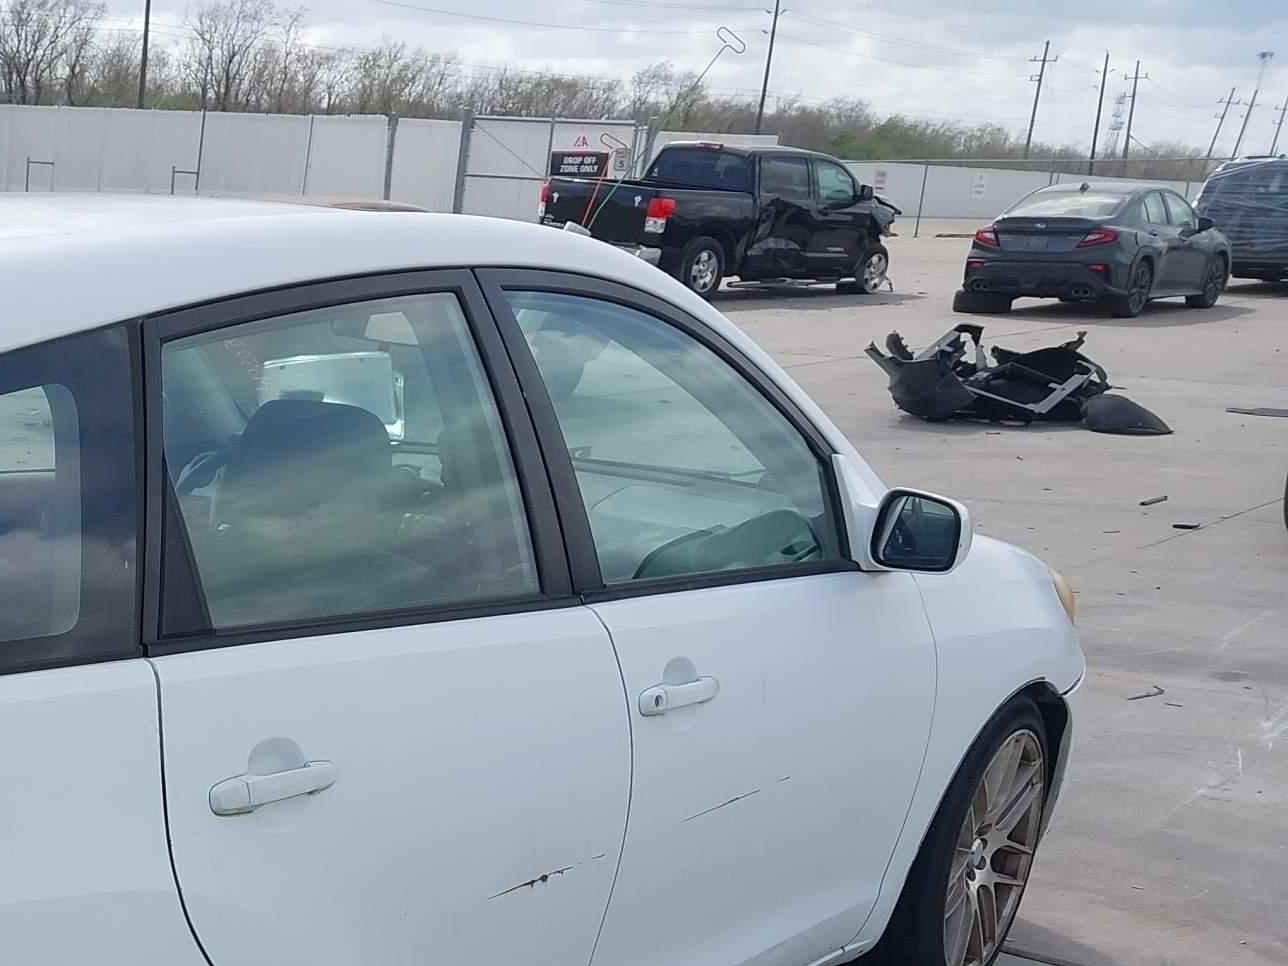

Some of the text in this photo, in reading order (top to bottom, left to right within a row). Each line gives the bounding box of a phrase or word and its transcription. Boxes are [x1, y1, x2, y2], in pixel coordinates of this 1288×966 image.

[563, 156, 597, 164] DROP OFF
[560, 165, 599, 173] ZONE ONLY
